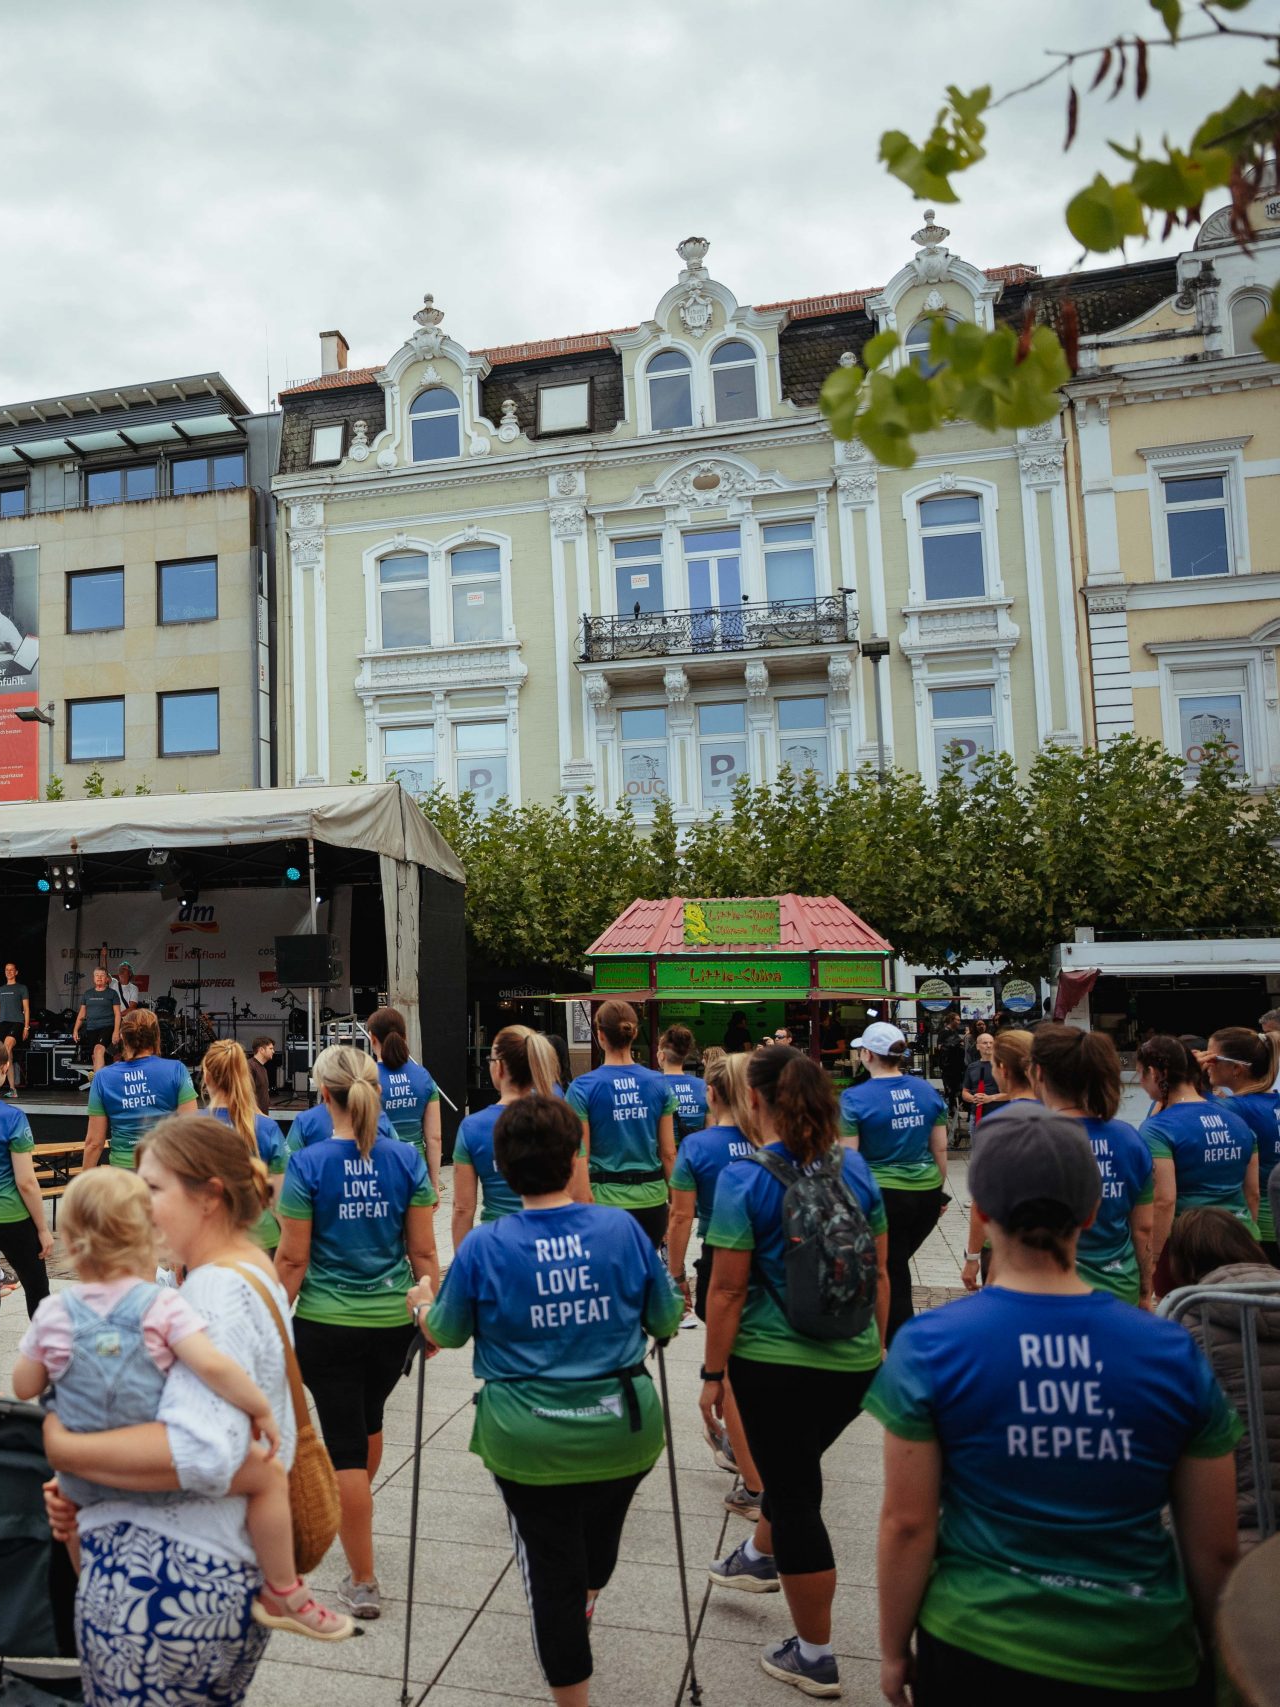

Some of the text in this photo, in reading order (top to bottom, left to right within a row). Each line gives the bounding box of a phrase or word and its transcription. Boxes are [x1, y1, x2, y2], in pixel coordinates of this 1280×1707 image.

[626, 779, 666, 796] OUC
[179, 902, 215, 921] dm
[689, 967, 782, 983] Little-China
[124, 1070, 147, 1083] RUN,
[389, 1073, 410, 1085] RUN,
[613, 1077, 640, 1090] RUN,
[124, 1083, 151, 1096] LOVE,
[390, 1085, 413, 1097] LOVE,
[675, 1083, 694, 1093] RUN,
[890, 1088, 915, 1101] RUN,
[122, 1095, 156, 1109] REPEAT
[385, 1097, 418, 1110] REPEAT
[614, 1092, 643, 1106] LOVE,
[612, 1106, 649, 1121] REPEAT
[893, 1101, 920, 1115] LOVE,
[891, 1114, 925, 1130] REPEAT
[1200, 1114, 1228, 1129] RUN,
[1205, 1131, 1235, 1146] LOVE,
[1204, 1146, 1242, 1163] REPEAT
[344, 1159, 378, 1176] RUN,
[343, 1180, 382, 1198] LOVE,
[1102, 1181, 1124, 1199] EAT
[338, 1201, 389, 1220] REPEAT
[535, 1234, 590, 1263] RUN,
[536, 1265, 599, 1296] LOVE,
[530, 1296, 611, 1328] REPEAT
[1019, 1333, 1104, 1375] RUN,
[1018, 1379, 1115, 1420] LOVE,
[1007, 1425, 1134, 1461] REPEAT
